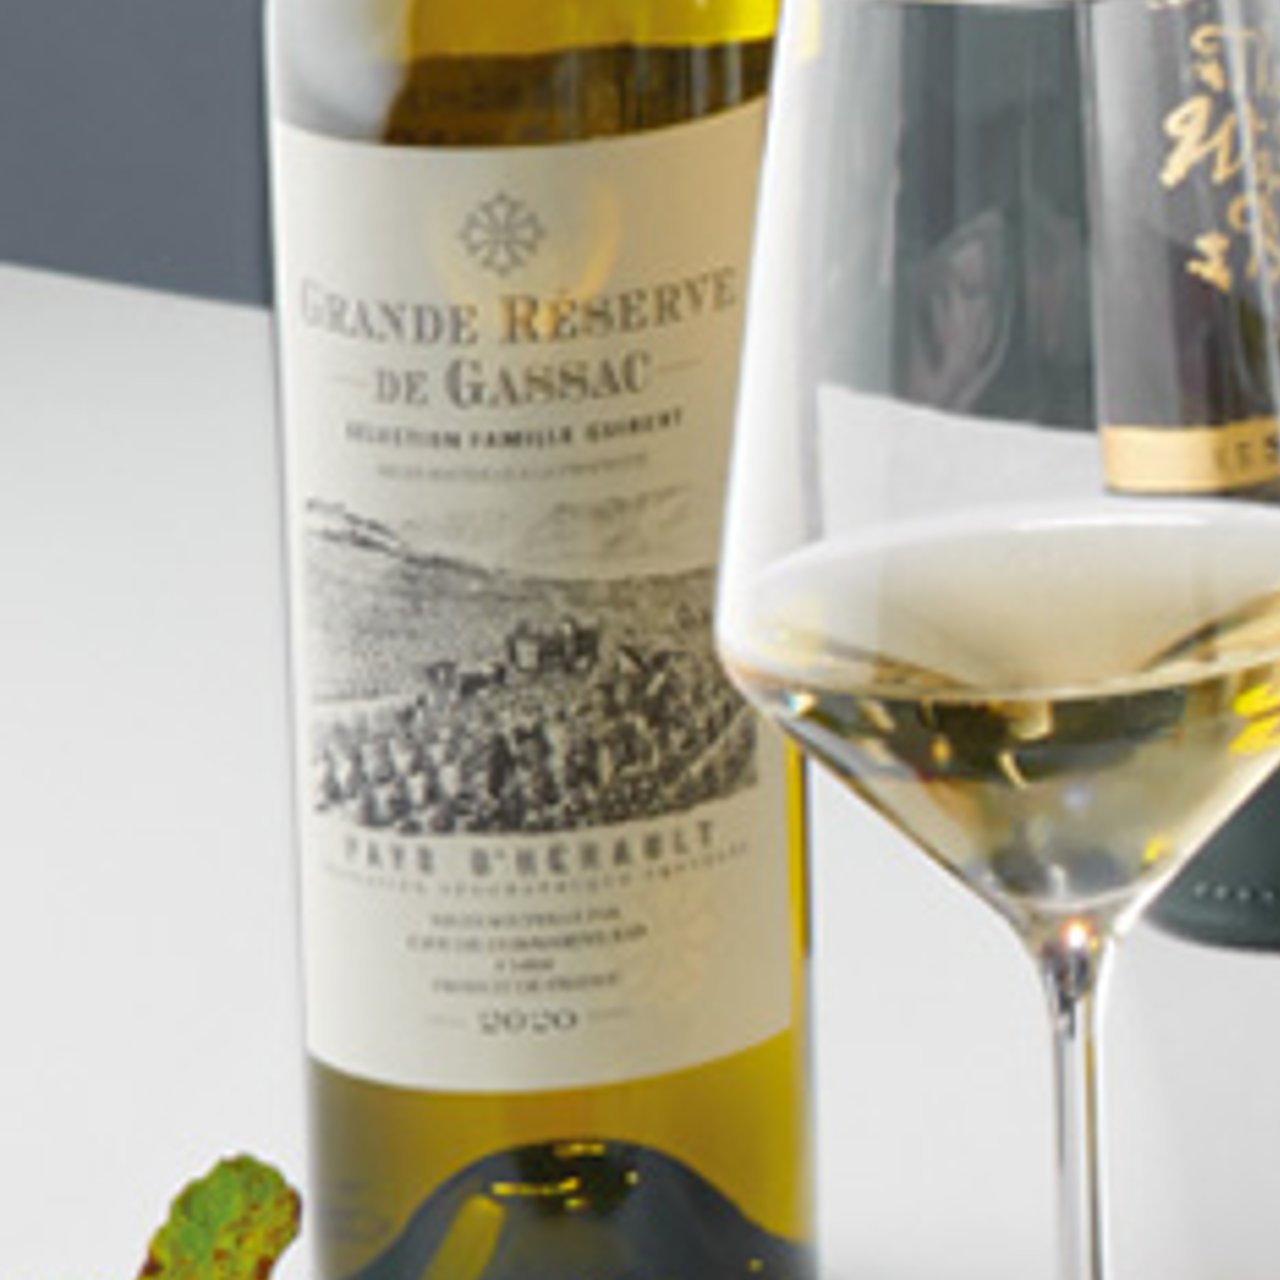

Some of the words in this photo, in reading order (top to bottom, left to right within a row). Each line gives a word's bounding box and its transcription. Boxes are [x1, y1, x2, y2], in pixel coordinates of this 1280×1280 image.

[298, 278, 480, 346] GRANDE
[375, 368, 430, 407] DE
[444, 350, 652, 410] GASSAC
[478, 1006, 578, 1036] 2020
